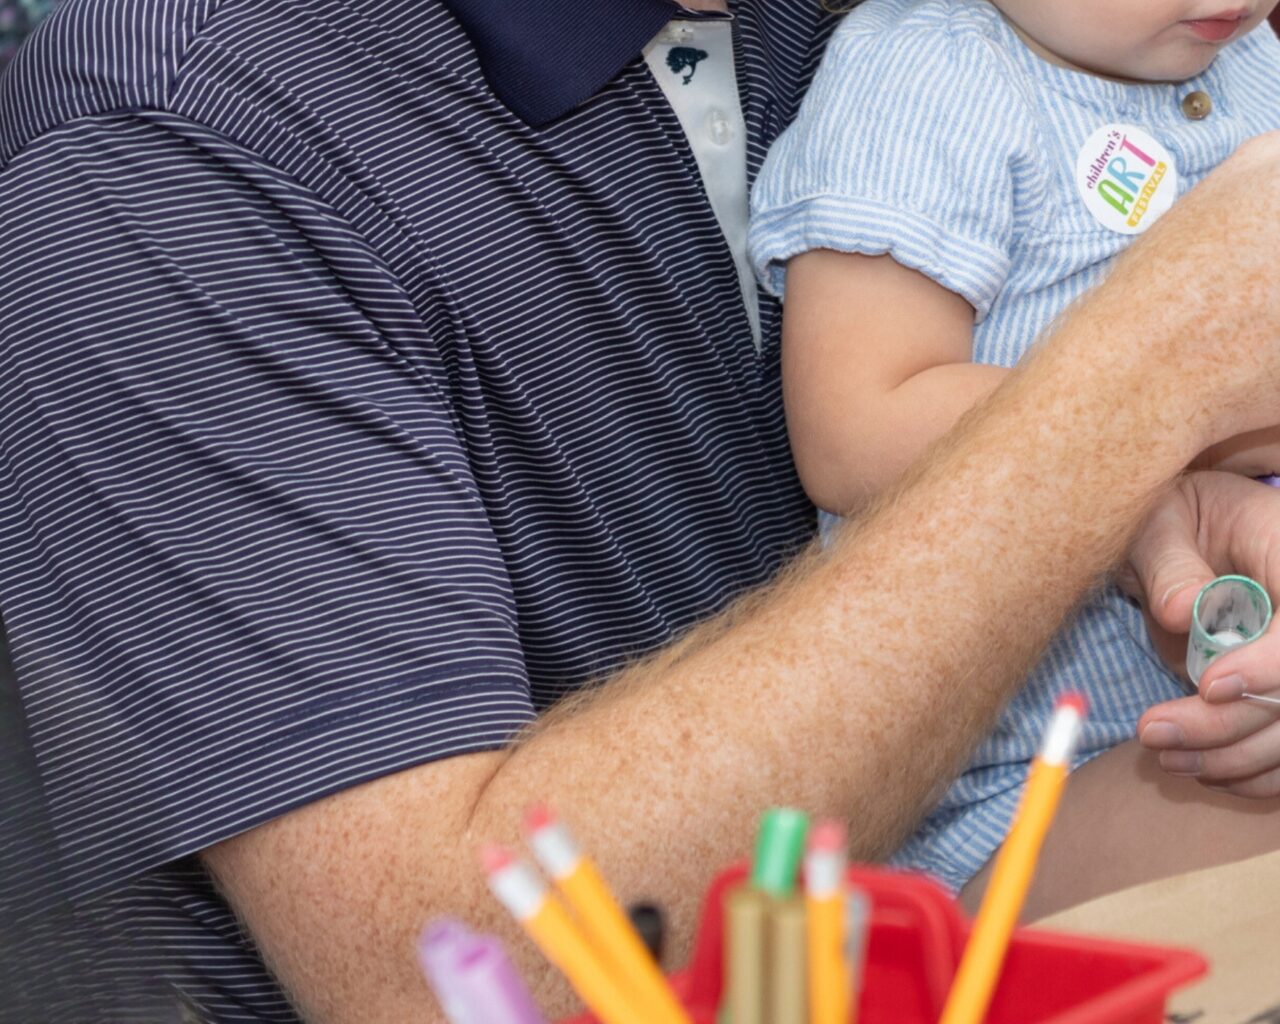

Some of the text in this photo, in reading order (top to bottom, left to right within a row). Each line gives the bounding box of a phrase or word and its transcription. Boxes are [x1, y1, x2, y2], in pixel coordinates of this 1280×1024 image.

[1086, 130, 1121, 189] children's
[1098, 134, 1156, 215] ART
[1128, 162, 1166, 224] FESTIVAL
